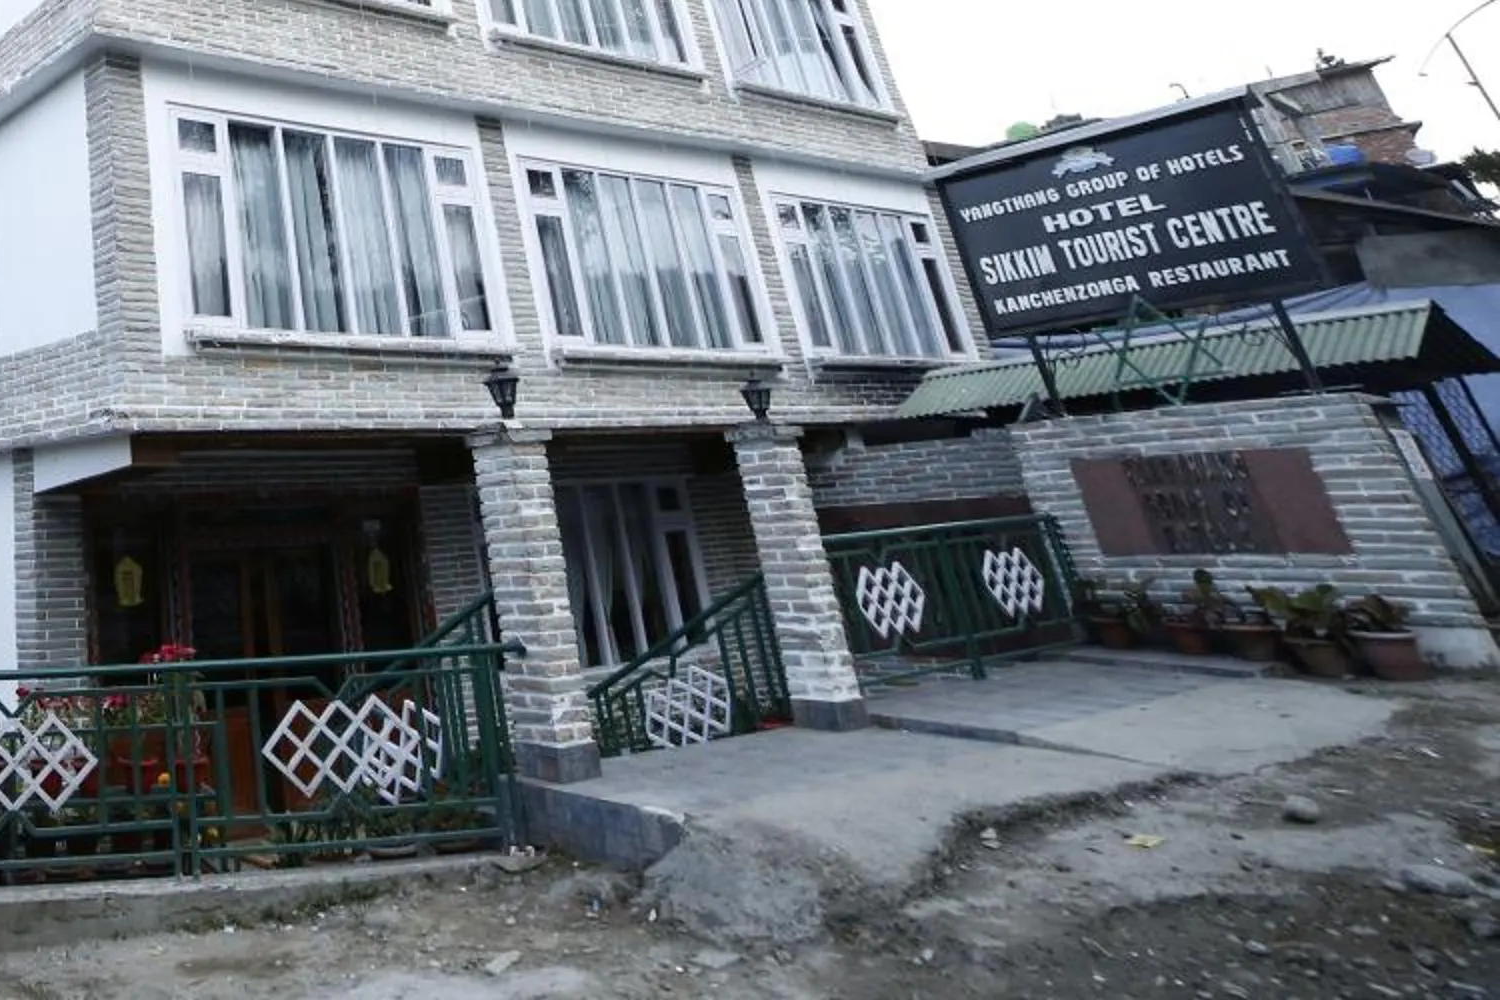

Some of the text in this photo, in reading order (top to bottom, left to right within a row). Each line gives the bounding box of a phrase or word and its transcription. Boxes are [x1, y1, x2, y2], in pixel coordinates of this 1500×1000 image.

[960, 145, 1244, 223] YANGTHANG GROUP OF HOTELS
[1042, 194, 1167, 232] HOTEL
[979, 201, 1277, 285] SIKKIM TOURIST CENTRE
[993, 249, 1291, 314] KANCHENZONGA RESTAURANT
